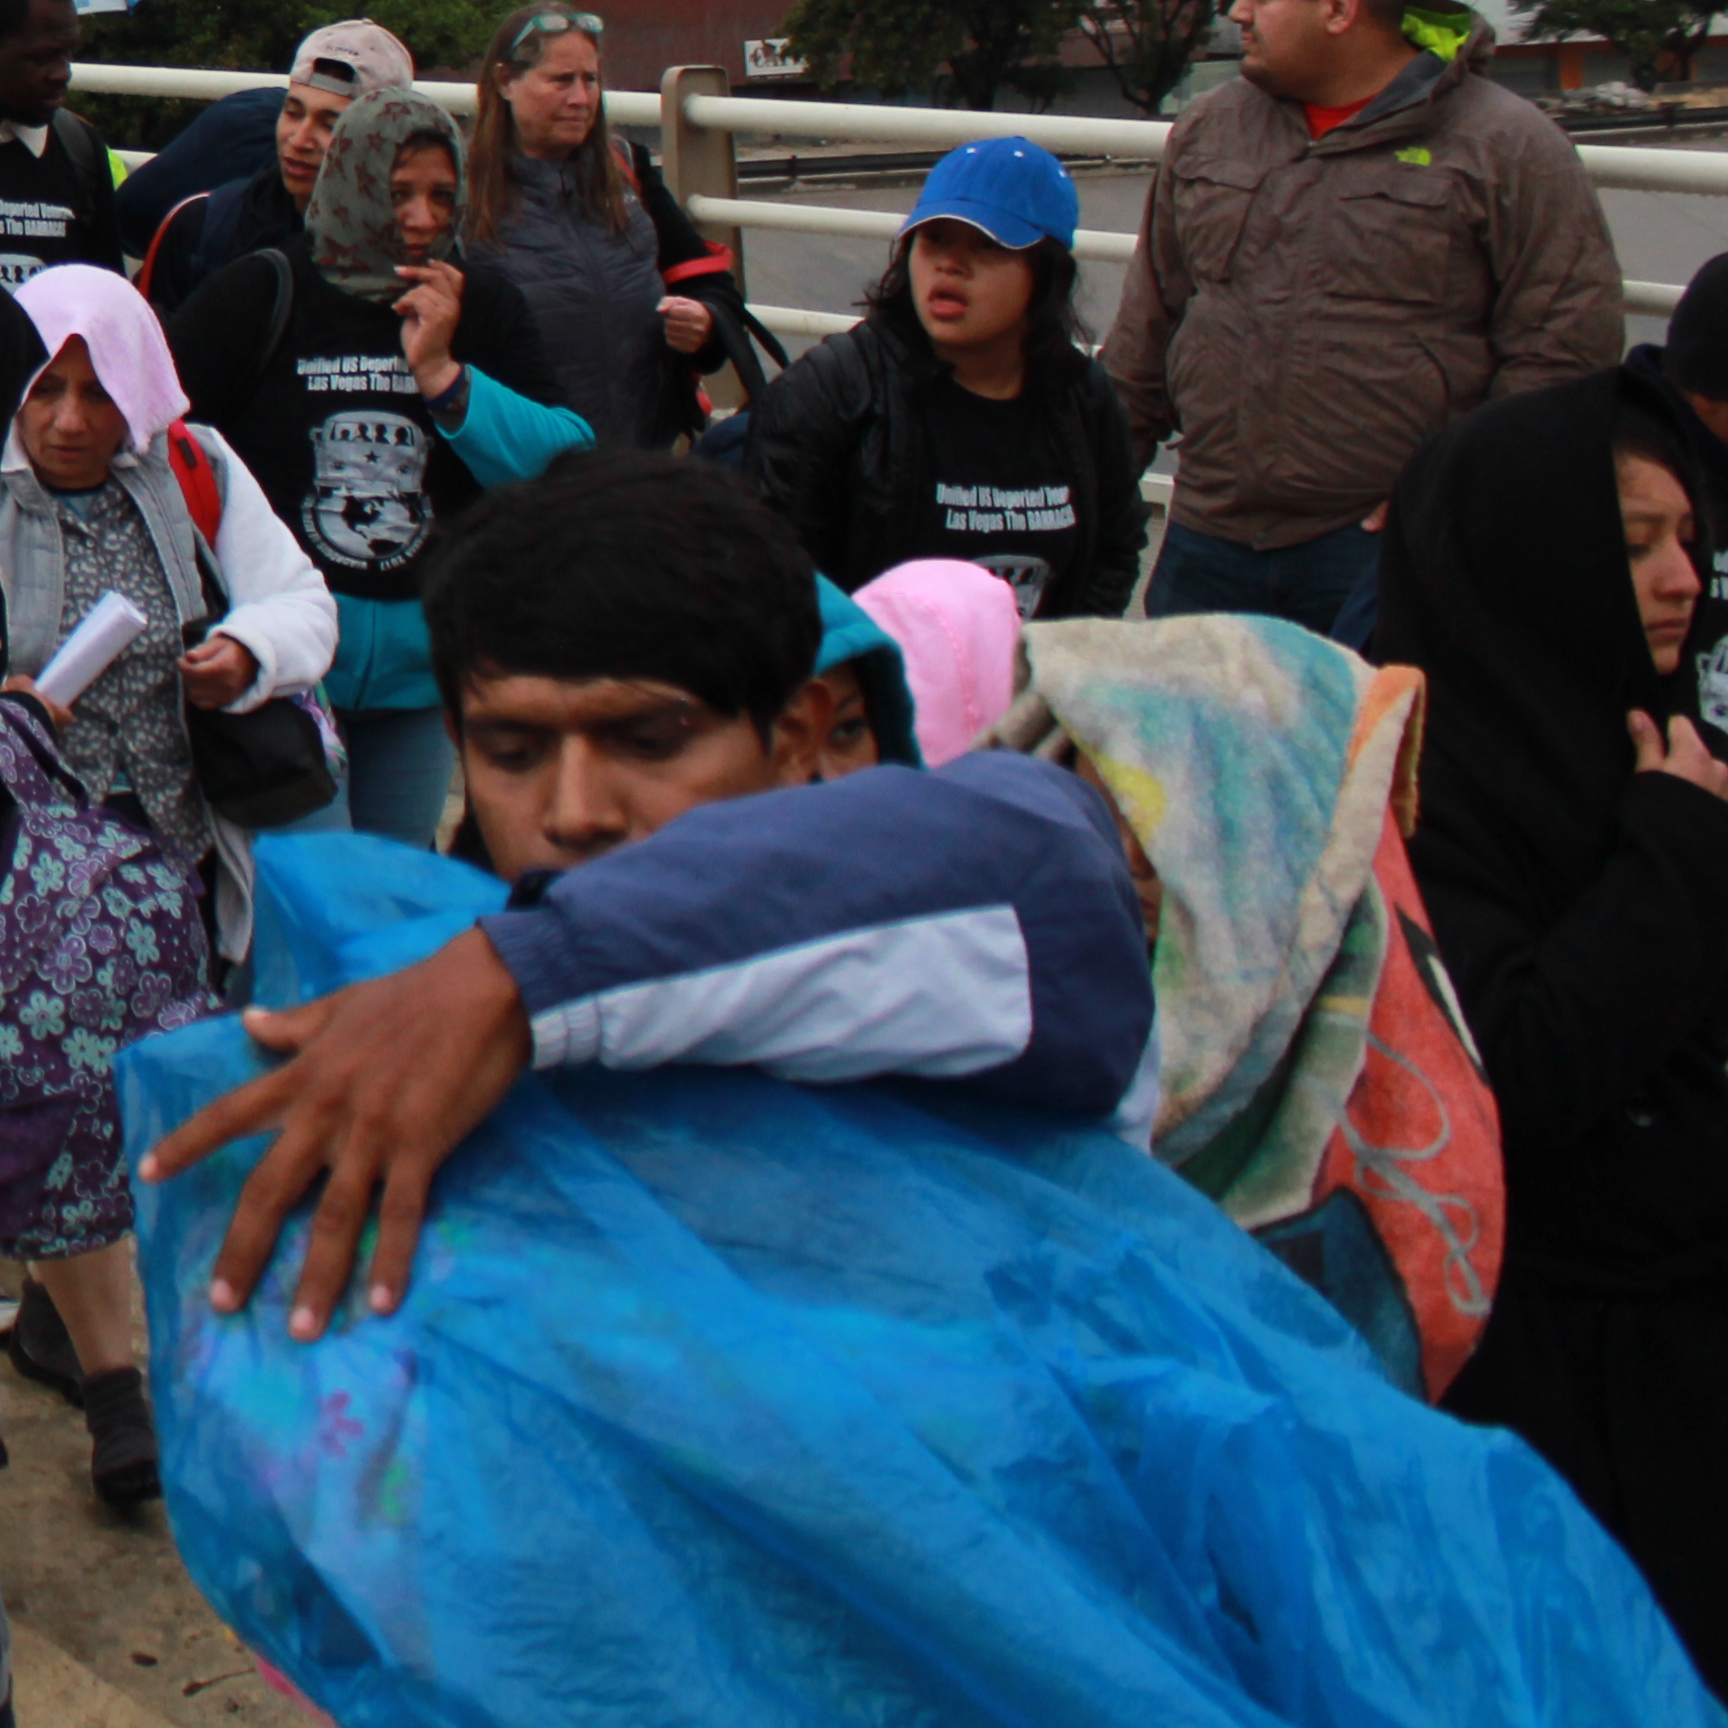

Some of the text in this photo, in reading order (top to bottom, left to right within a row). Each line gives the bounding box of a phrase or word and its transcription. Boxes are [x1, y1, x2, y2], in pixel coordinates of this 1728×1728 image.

[5, 218, 24, 235] The
[341, 356, 359, 373] US
[307, 375, 329, 391] Las
[329, 374, 368, 392] Vegas
[369, 373, 391, 391] The
[945, 507, 967, 531] Las
[968, 509, 1005, 533] Vegas
[1004, 510, 1027, 531] The
